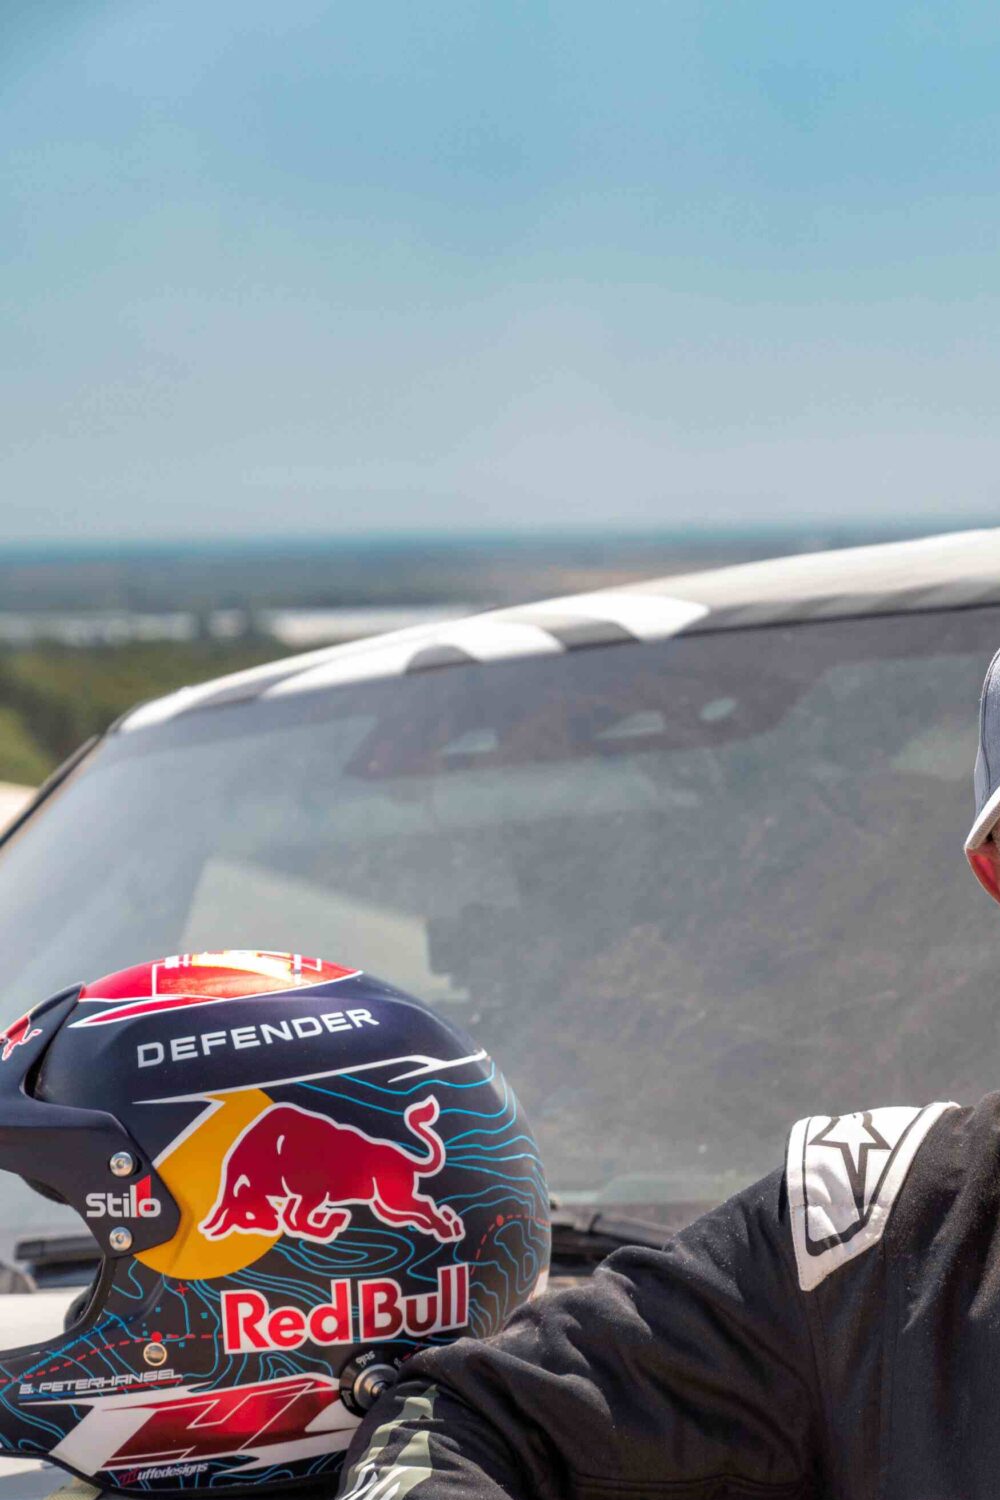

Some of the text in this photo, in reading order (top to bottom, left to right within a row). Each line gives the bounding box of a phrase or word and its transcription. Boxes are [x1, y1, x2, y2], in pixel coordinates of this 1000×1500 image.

[137, 1008, 379, 1068] DEFENDER
[85, 1174, 161, 1217] Stilo
[220, 1262, 469, 1354] Red Bull
[19, 1368, 183, 1395] S. PETERHANSEL
